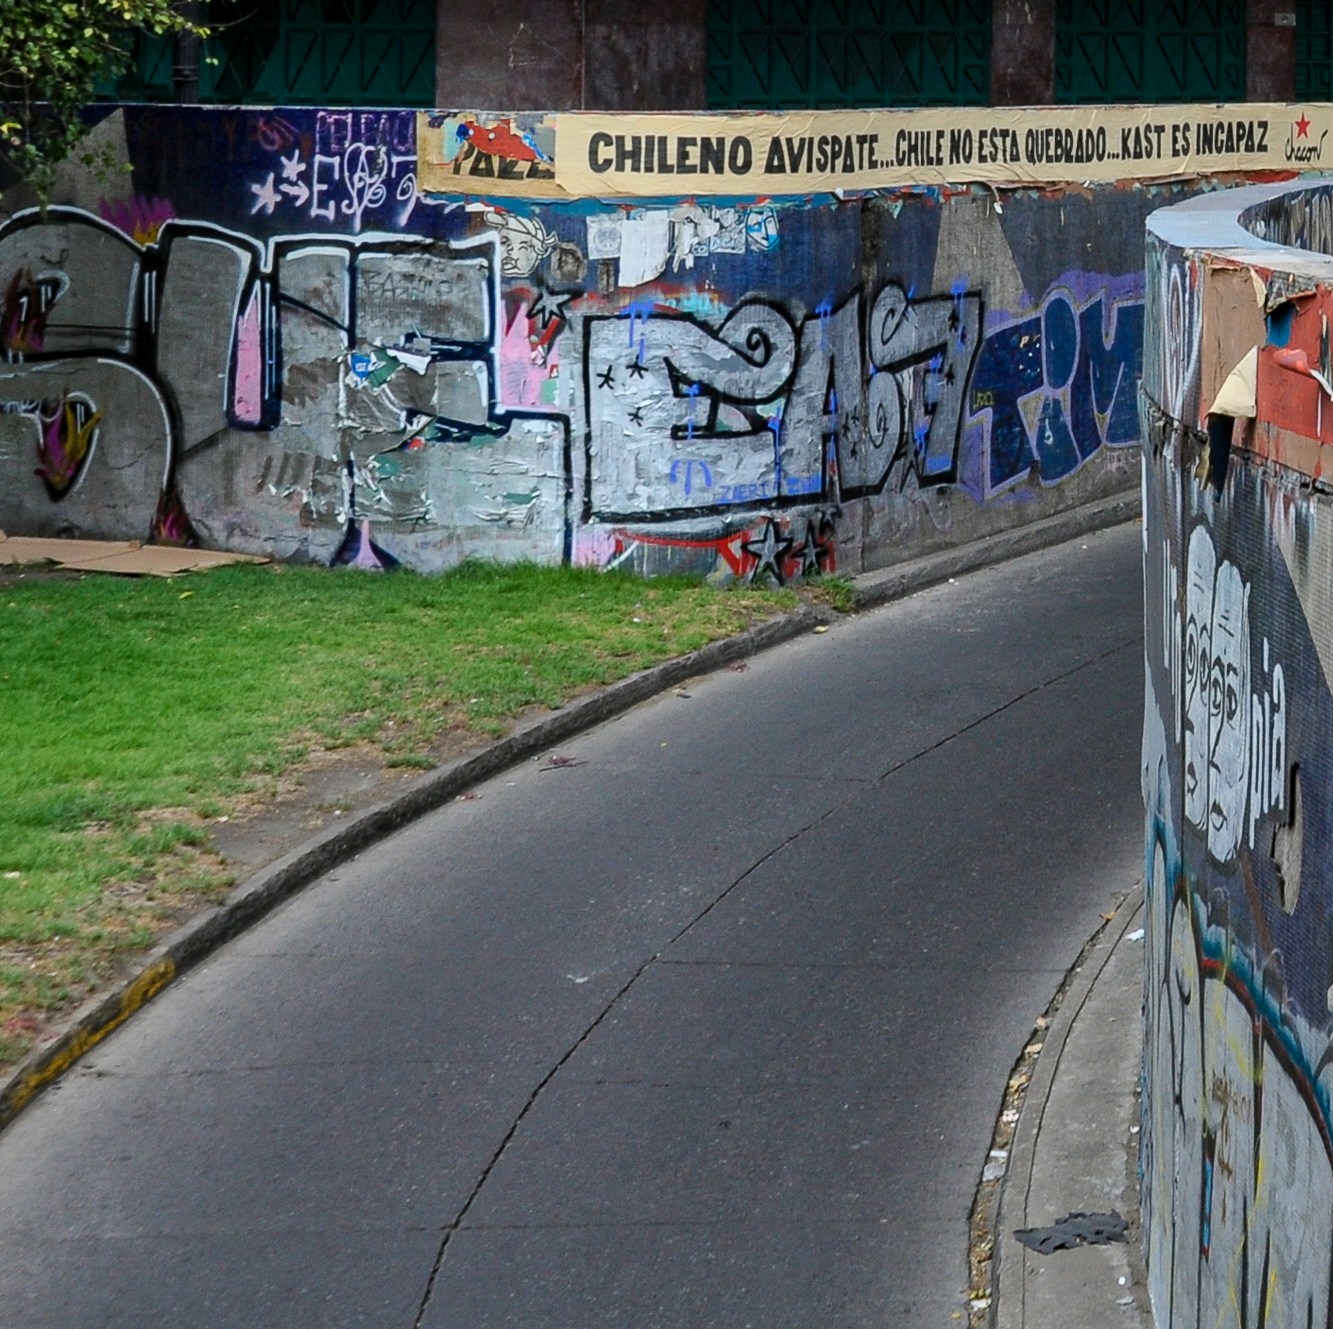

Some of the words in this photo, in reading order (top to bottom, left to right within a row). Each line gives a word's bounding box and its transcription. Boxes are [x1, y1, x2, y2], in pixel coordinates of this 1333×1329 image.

[588, 132, 752, 175] CHILENO
[949, 129, 973, 164] NO
[978, 127, 1020, 163] ESTA
[1121, 125, 1165, 160] KAST
[1171, 122, 1191, 157] ES
[1196, 120, 1268, 156] INCAPAZ
